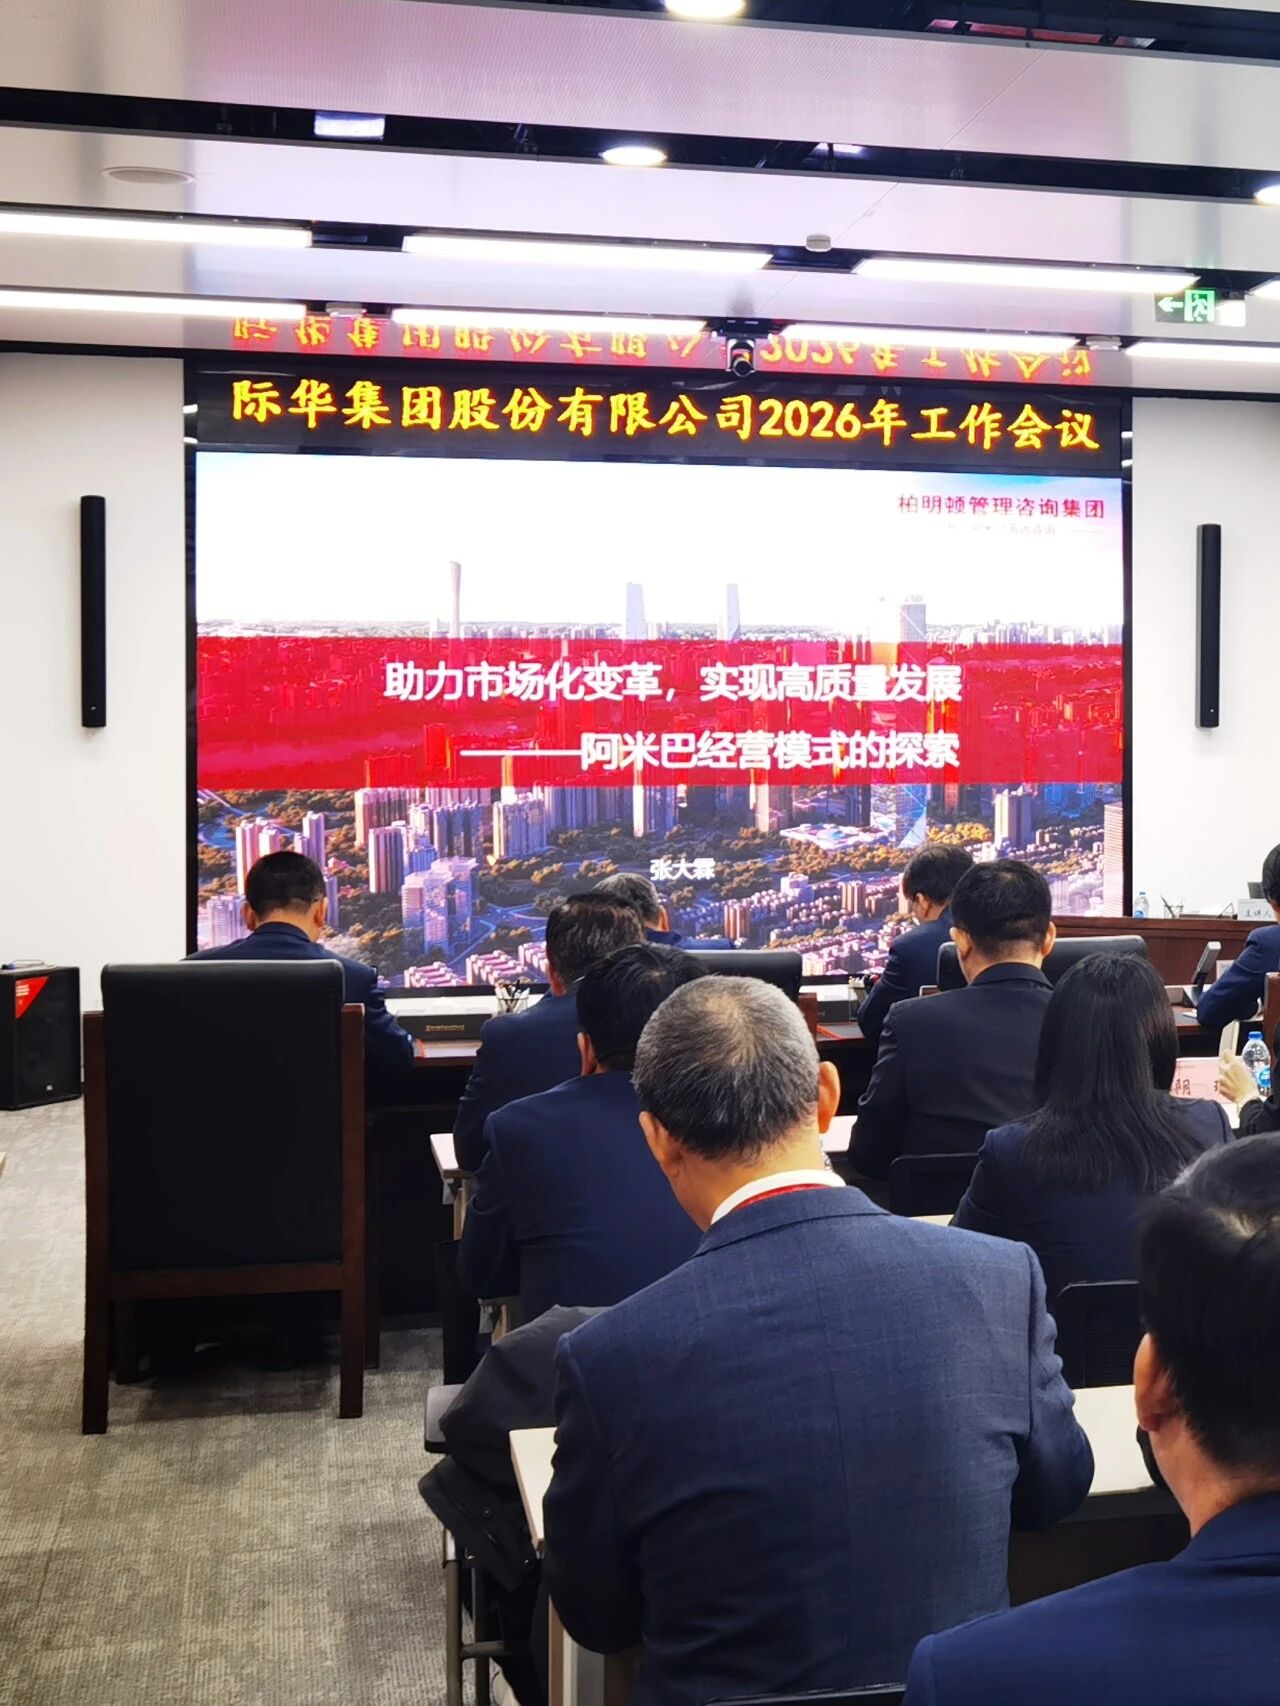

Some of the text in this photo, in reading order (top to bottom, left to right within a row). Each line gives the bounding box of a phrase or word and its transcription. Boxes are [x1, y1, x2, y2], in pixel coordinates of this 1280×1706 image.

[231, 378, 1100, 451] 际华集团股份有限公司2026年工作会议
[897, 493, 1105, 519] 柏明顿管理咨询集团
[383, 661, 963, 703] 助力市场化变革，实现高质量发展
